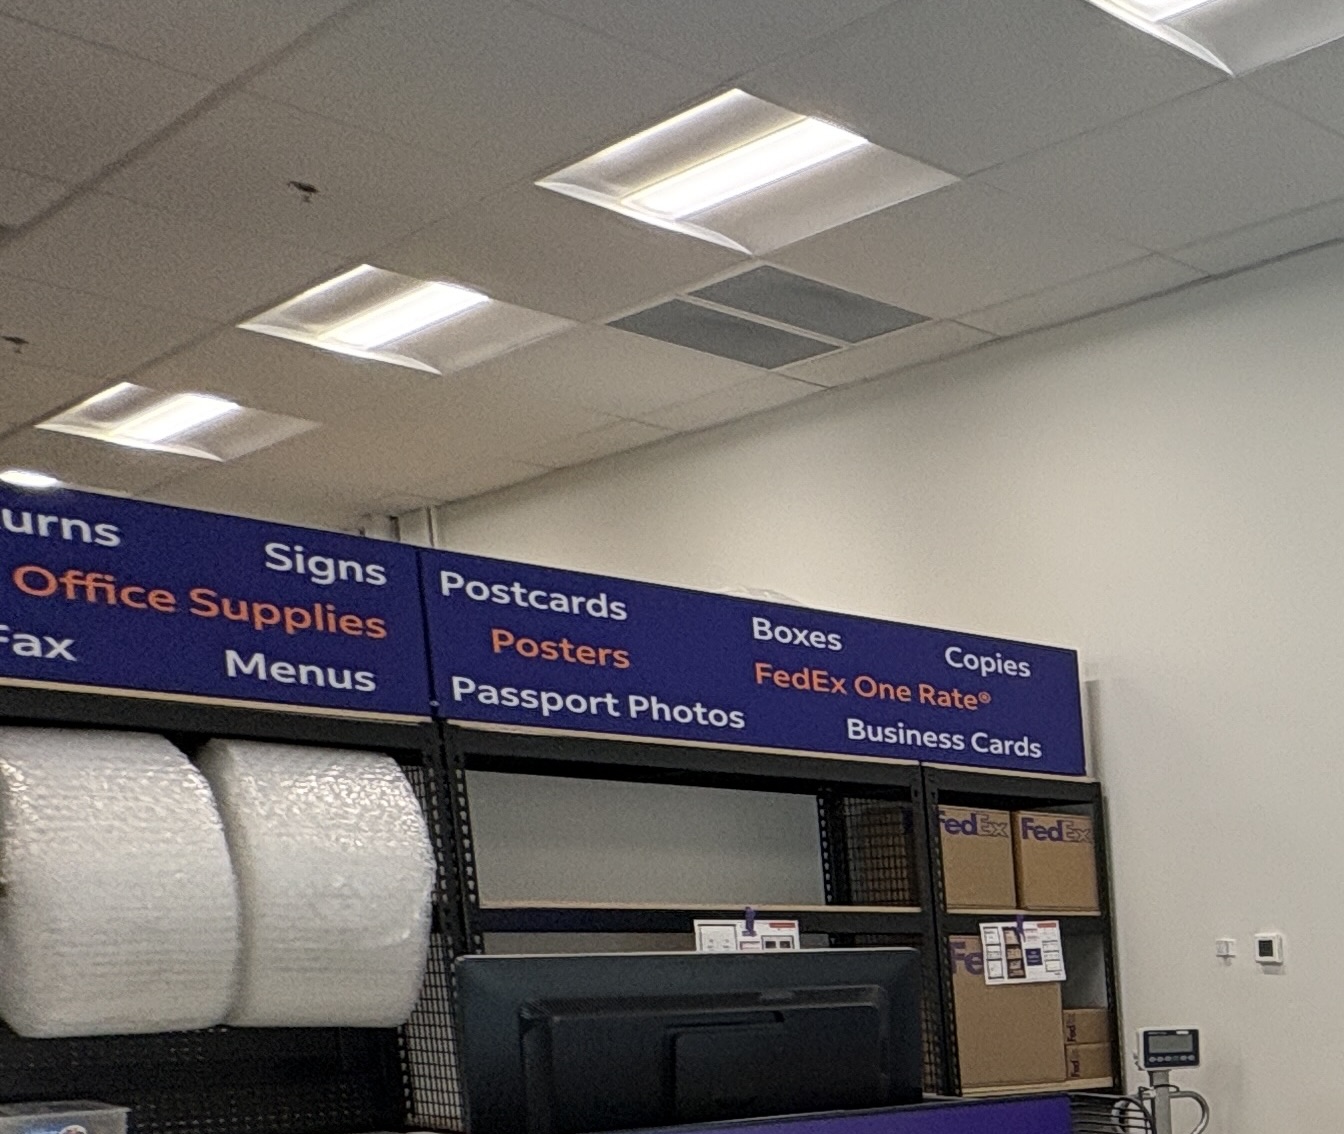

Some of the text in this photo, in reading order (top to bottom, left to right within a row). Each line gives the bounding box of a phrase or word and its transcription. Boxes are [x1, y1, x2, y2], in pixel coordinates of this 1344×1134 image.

[0, 508, 121, 547] urns
[265, 542, 387, 585] Signs
[12, 565, 388, 639] Office Supplies
[440, 570, 628, 620] Postcards
[491, 628, 631, 668] Posters
[752, 616, 842, 650] Boxes
[225, 650, 376, 691] Menus
[944, 646, 1031, 677] Copies
[451, 675, 745, 728] Passport Photos
[754, 662, 847, 695] FedEx
[854, 676, 911, 702] One
[846, 718, 1042, 758] Business Cards
[1021, 817, 1093, 844] FedEx
